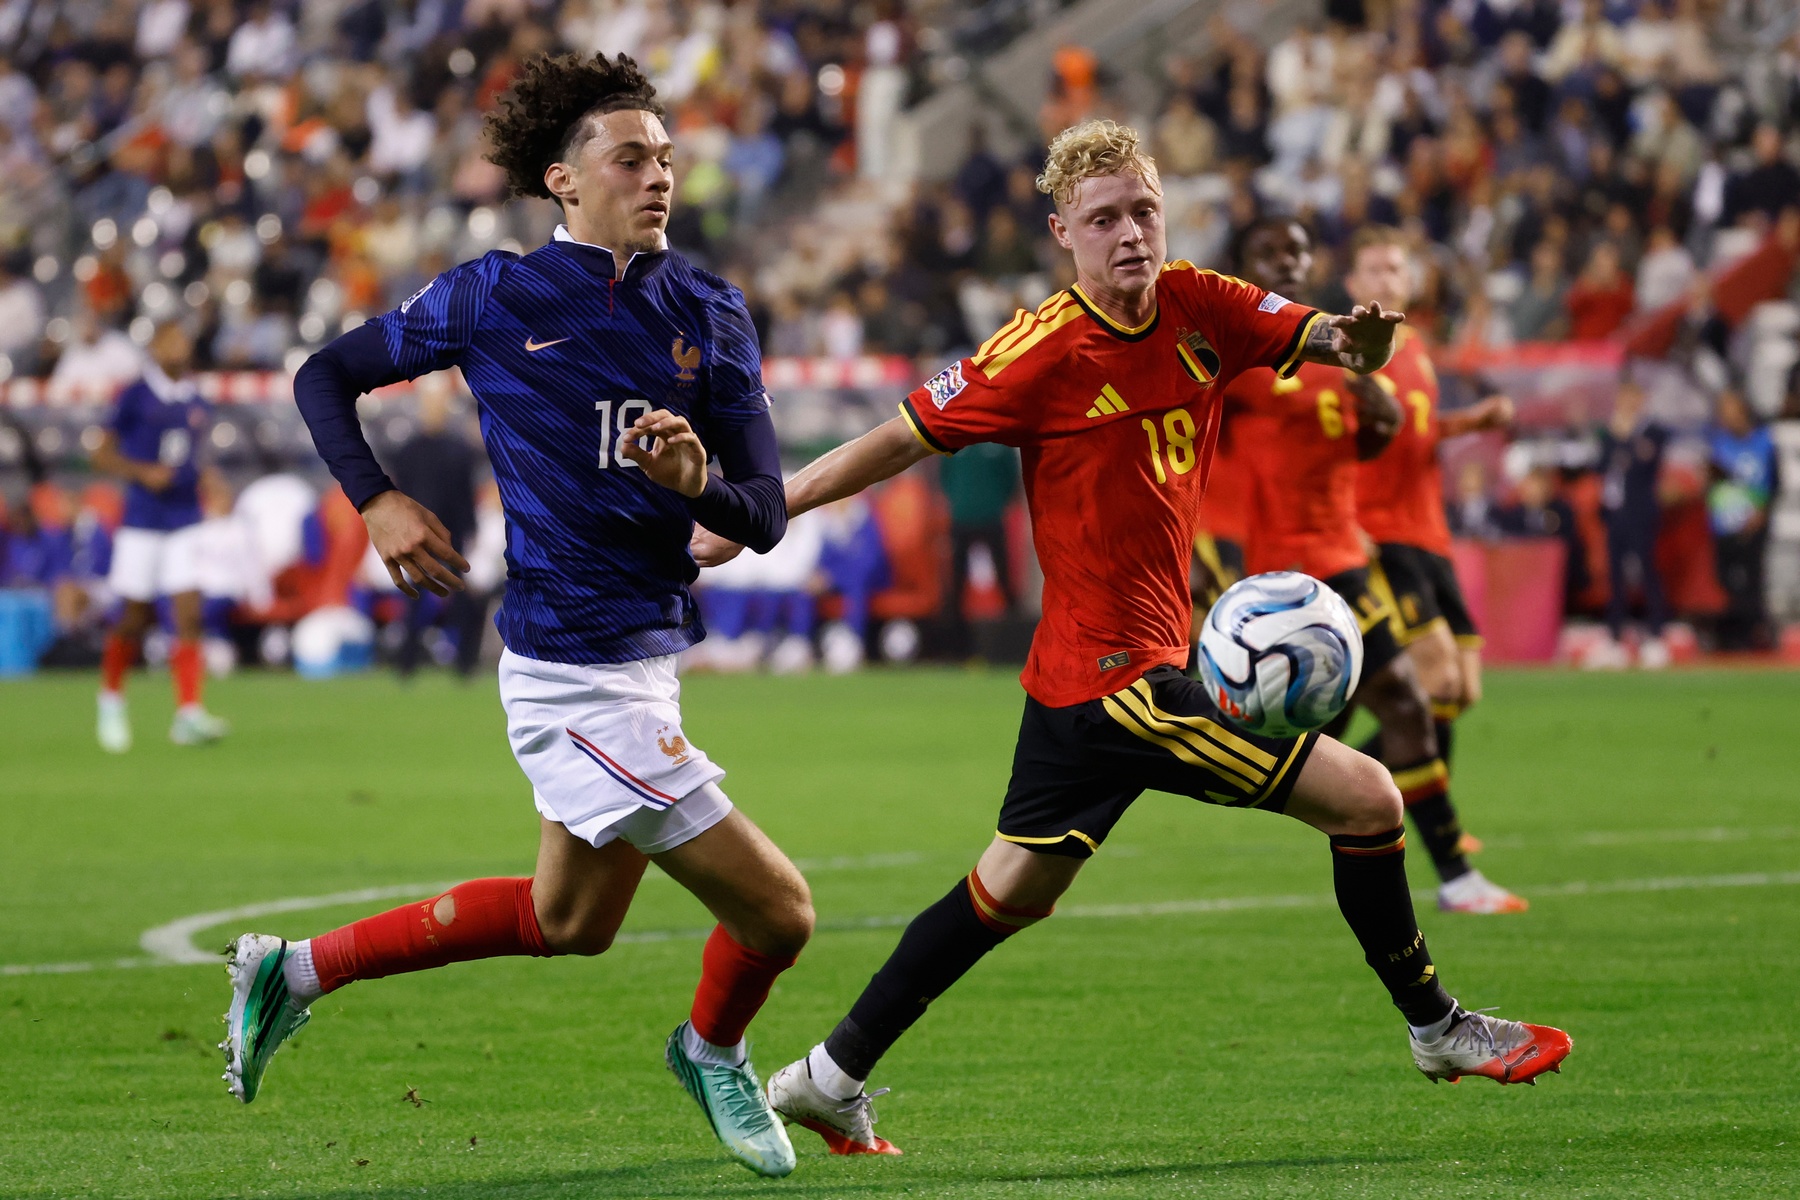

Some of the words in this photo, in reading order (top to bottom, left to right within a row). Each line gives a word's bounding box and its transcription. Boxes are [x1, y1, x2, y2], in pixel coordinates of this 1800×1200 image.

[594, 399, 652, 469] 18
[1317, 390, 1343, 439] 6
[1141, 408, 1196, 485] 18
[421, 903, 440, 947] FFF
